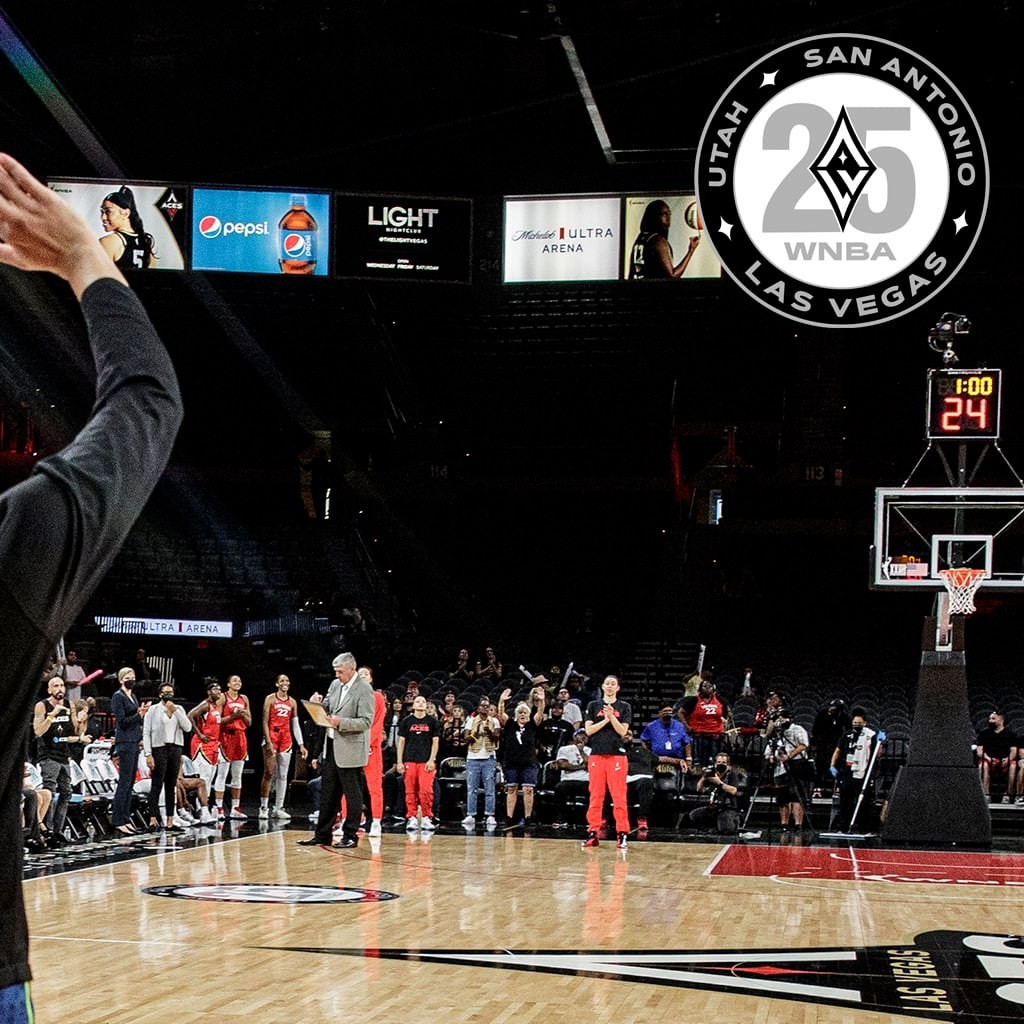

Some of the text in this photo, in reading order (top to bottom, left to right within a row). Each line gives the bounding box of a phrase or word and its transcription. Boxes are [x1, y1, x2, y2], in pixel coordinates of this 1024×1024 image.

[368, 206, 439, 228] LIGHT
[223, 221, 269, 237] pepsi
[568, 227, 614, 240] ULTRA
[542, 244, 584, 254] ARENA
[956, 376, 993, 396] 1:00
[942, 397, 987, 431] 24
[186, 623, 219, 633] ARENA
[887, 949, 953, 1011] LAS VEGAS
